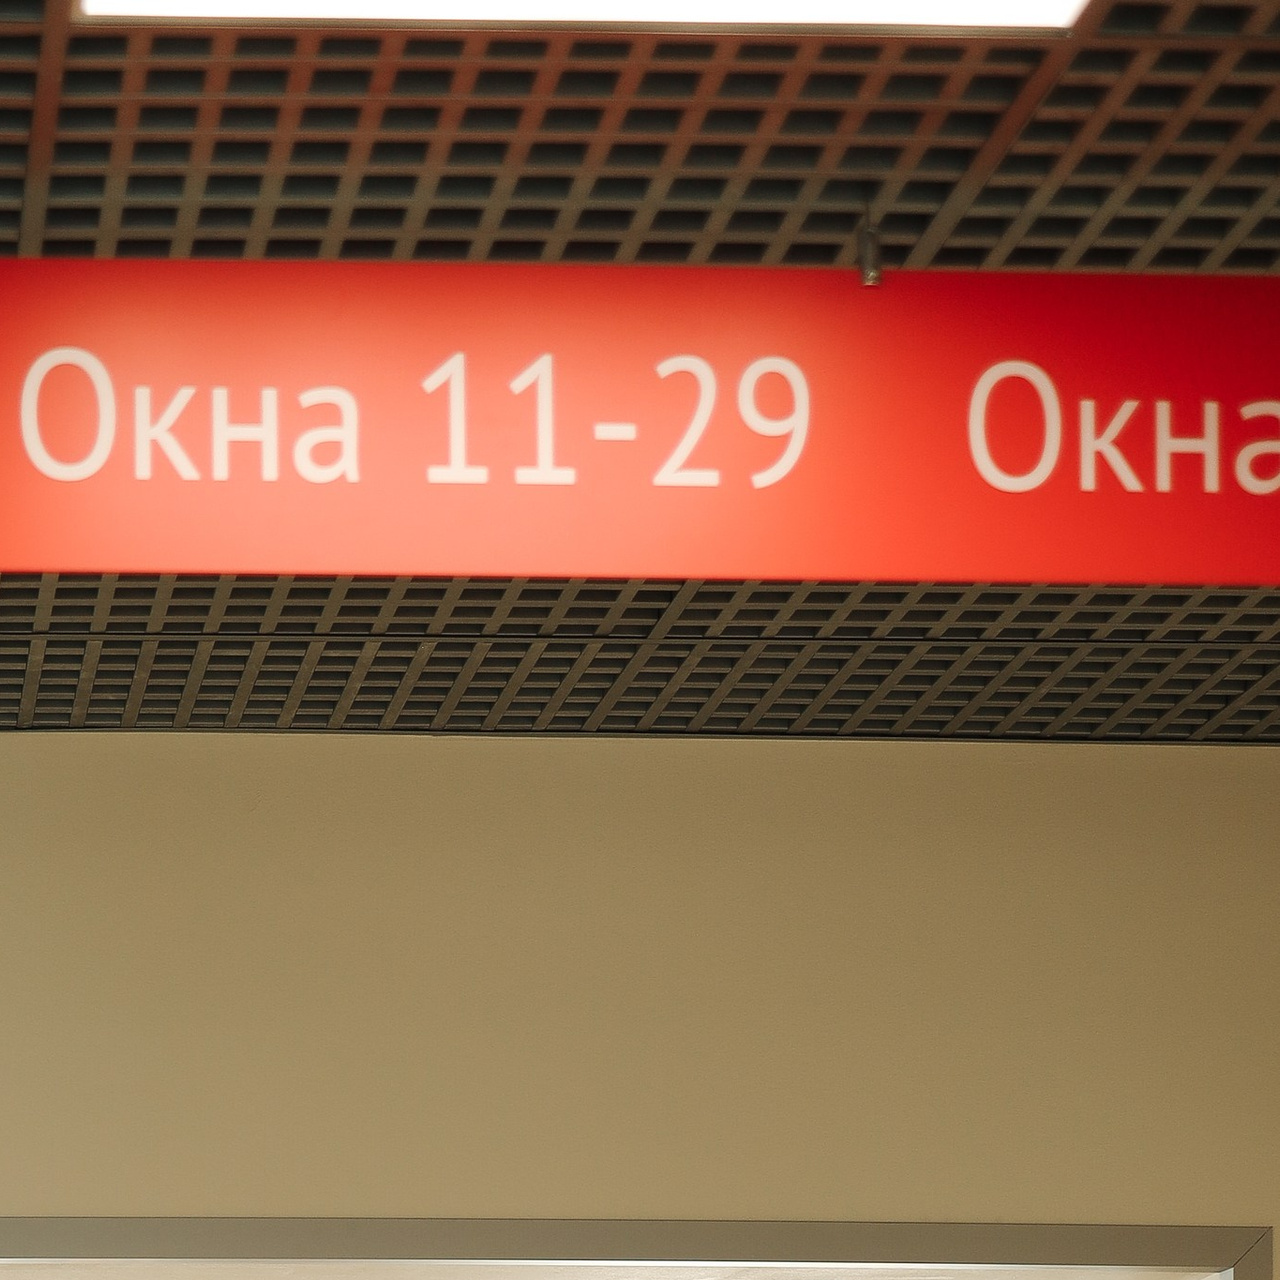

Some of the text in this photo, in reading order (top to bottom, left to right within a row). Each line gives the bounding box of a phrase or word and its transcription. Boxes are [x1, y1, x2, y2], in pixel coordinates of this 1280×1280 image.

[20, 347, 811, 489] Окна 11-29
[968, 359, 1280, 495] Окна
